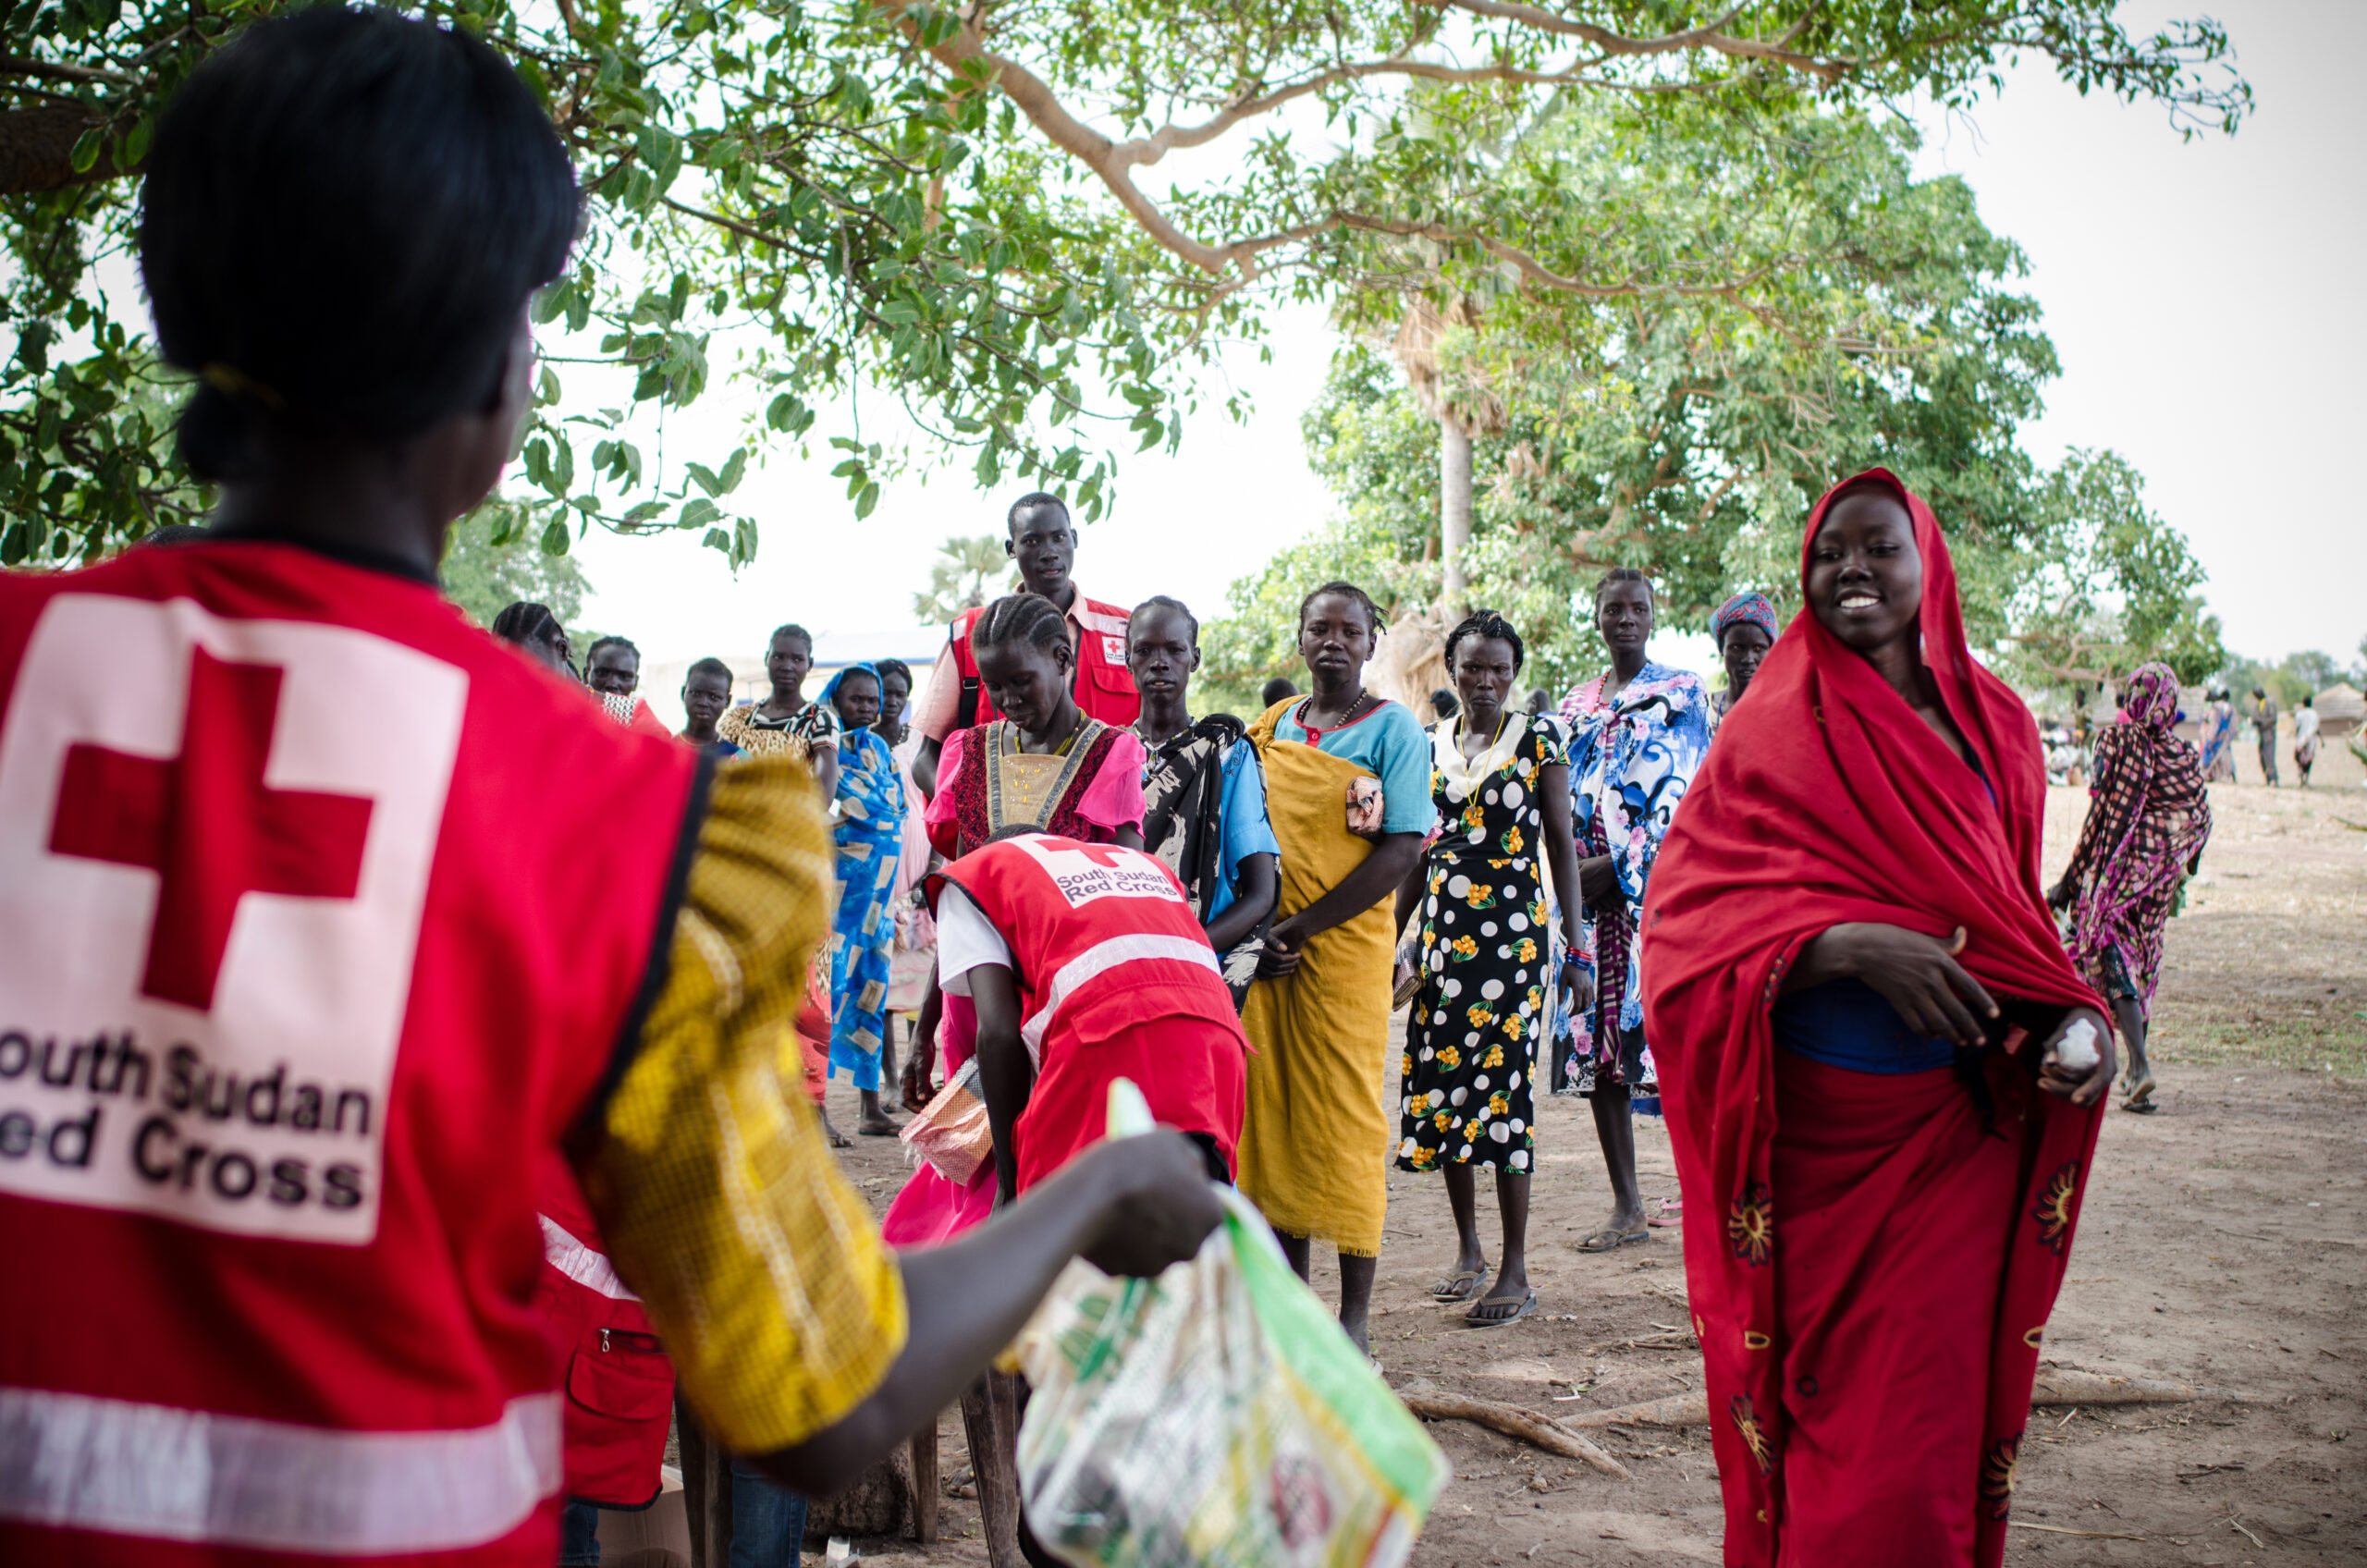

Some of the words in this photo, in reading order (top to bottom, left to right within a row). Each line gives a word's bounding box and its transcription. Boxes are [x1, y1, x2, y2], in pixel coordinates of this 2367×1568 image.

[1057, 868, 1112, 888] South
[1114, 871, 1169, 885] Sudan
[1065, 880, 1113, 902] Red
[1116, 881, 1178, 896] Cross
[0, 1026, 151, 1099] outh
[166, 1045, 371, 1135] Sudan
[0, 1106, 102, 1168] ed
[132, 1115, 363, 1209] Cross
